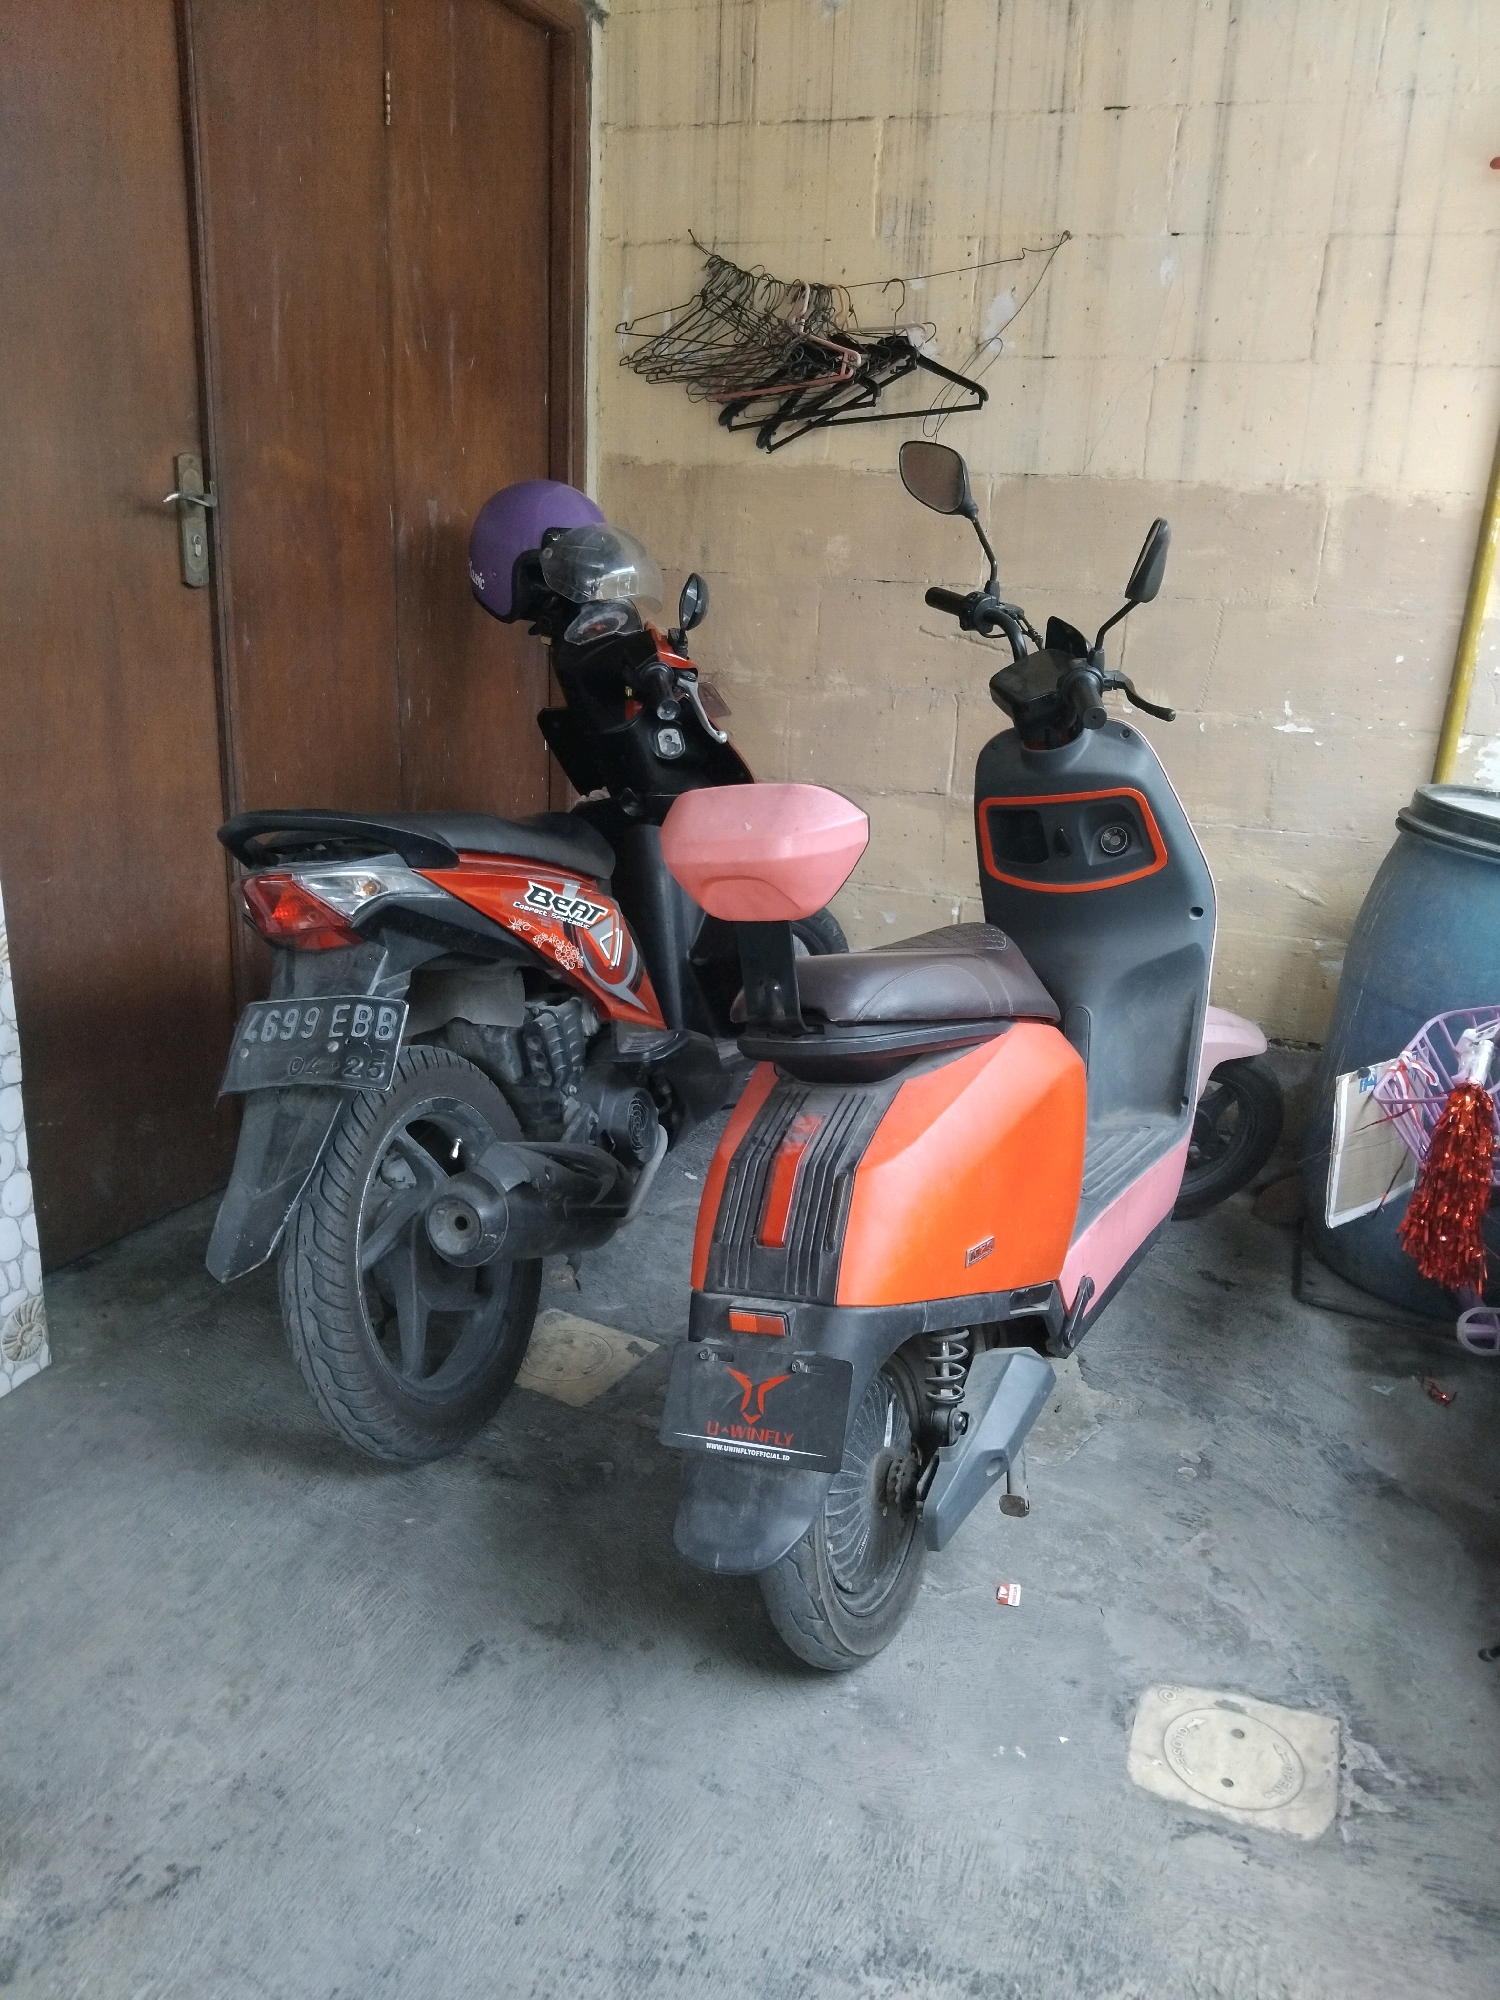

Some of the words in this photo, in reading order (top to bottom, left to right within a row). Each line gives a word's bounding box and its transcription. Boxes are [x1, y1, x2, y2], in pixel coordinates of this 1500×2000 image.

[242, 1006, 321, 1043] 4699
[328, 1004, 398, 1041] EBB
[1172, 1727, 1188, 1765] CLOSE
